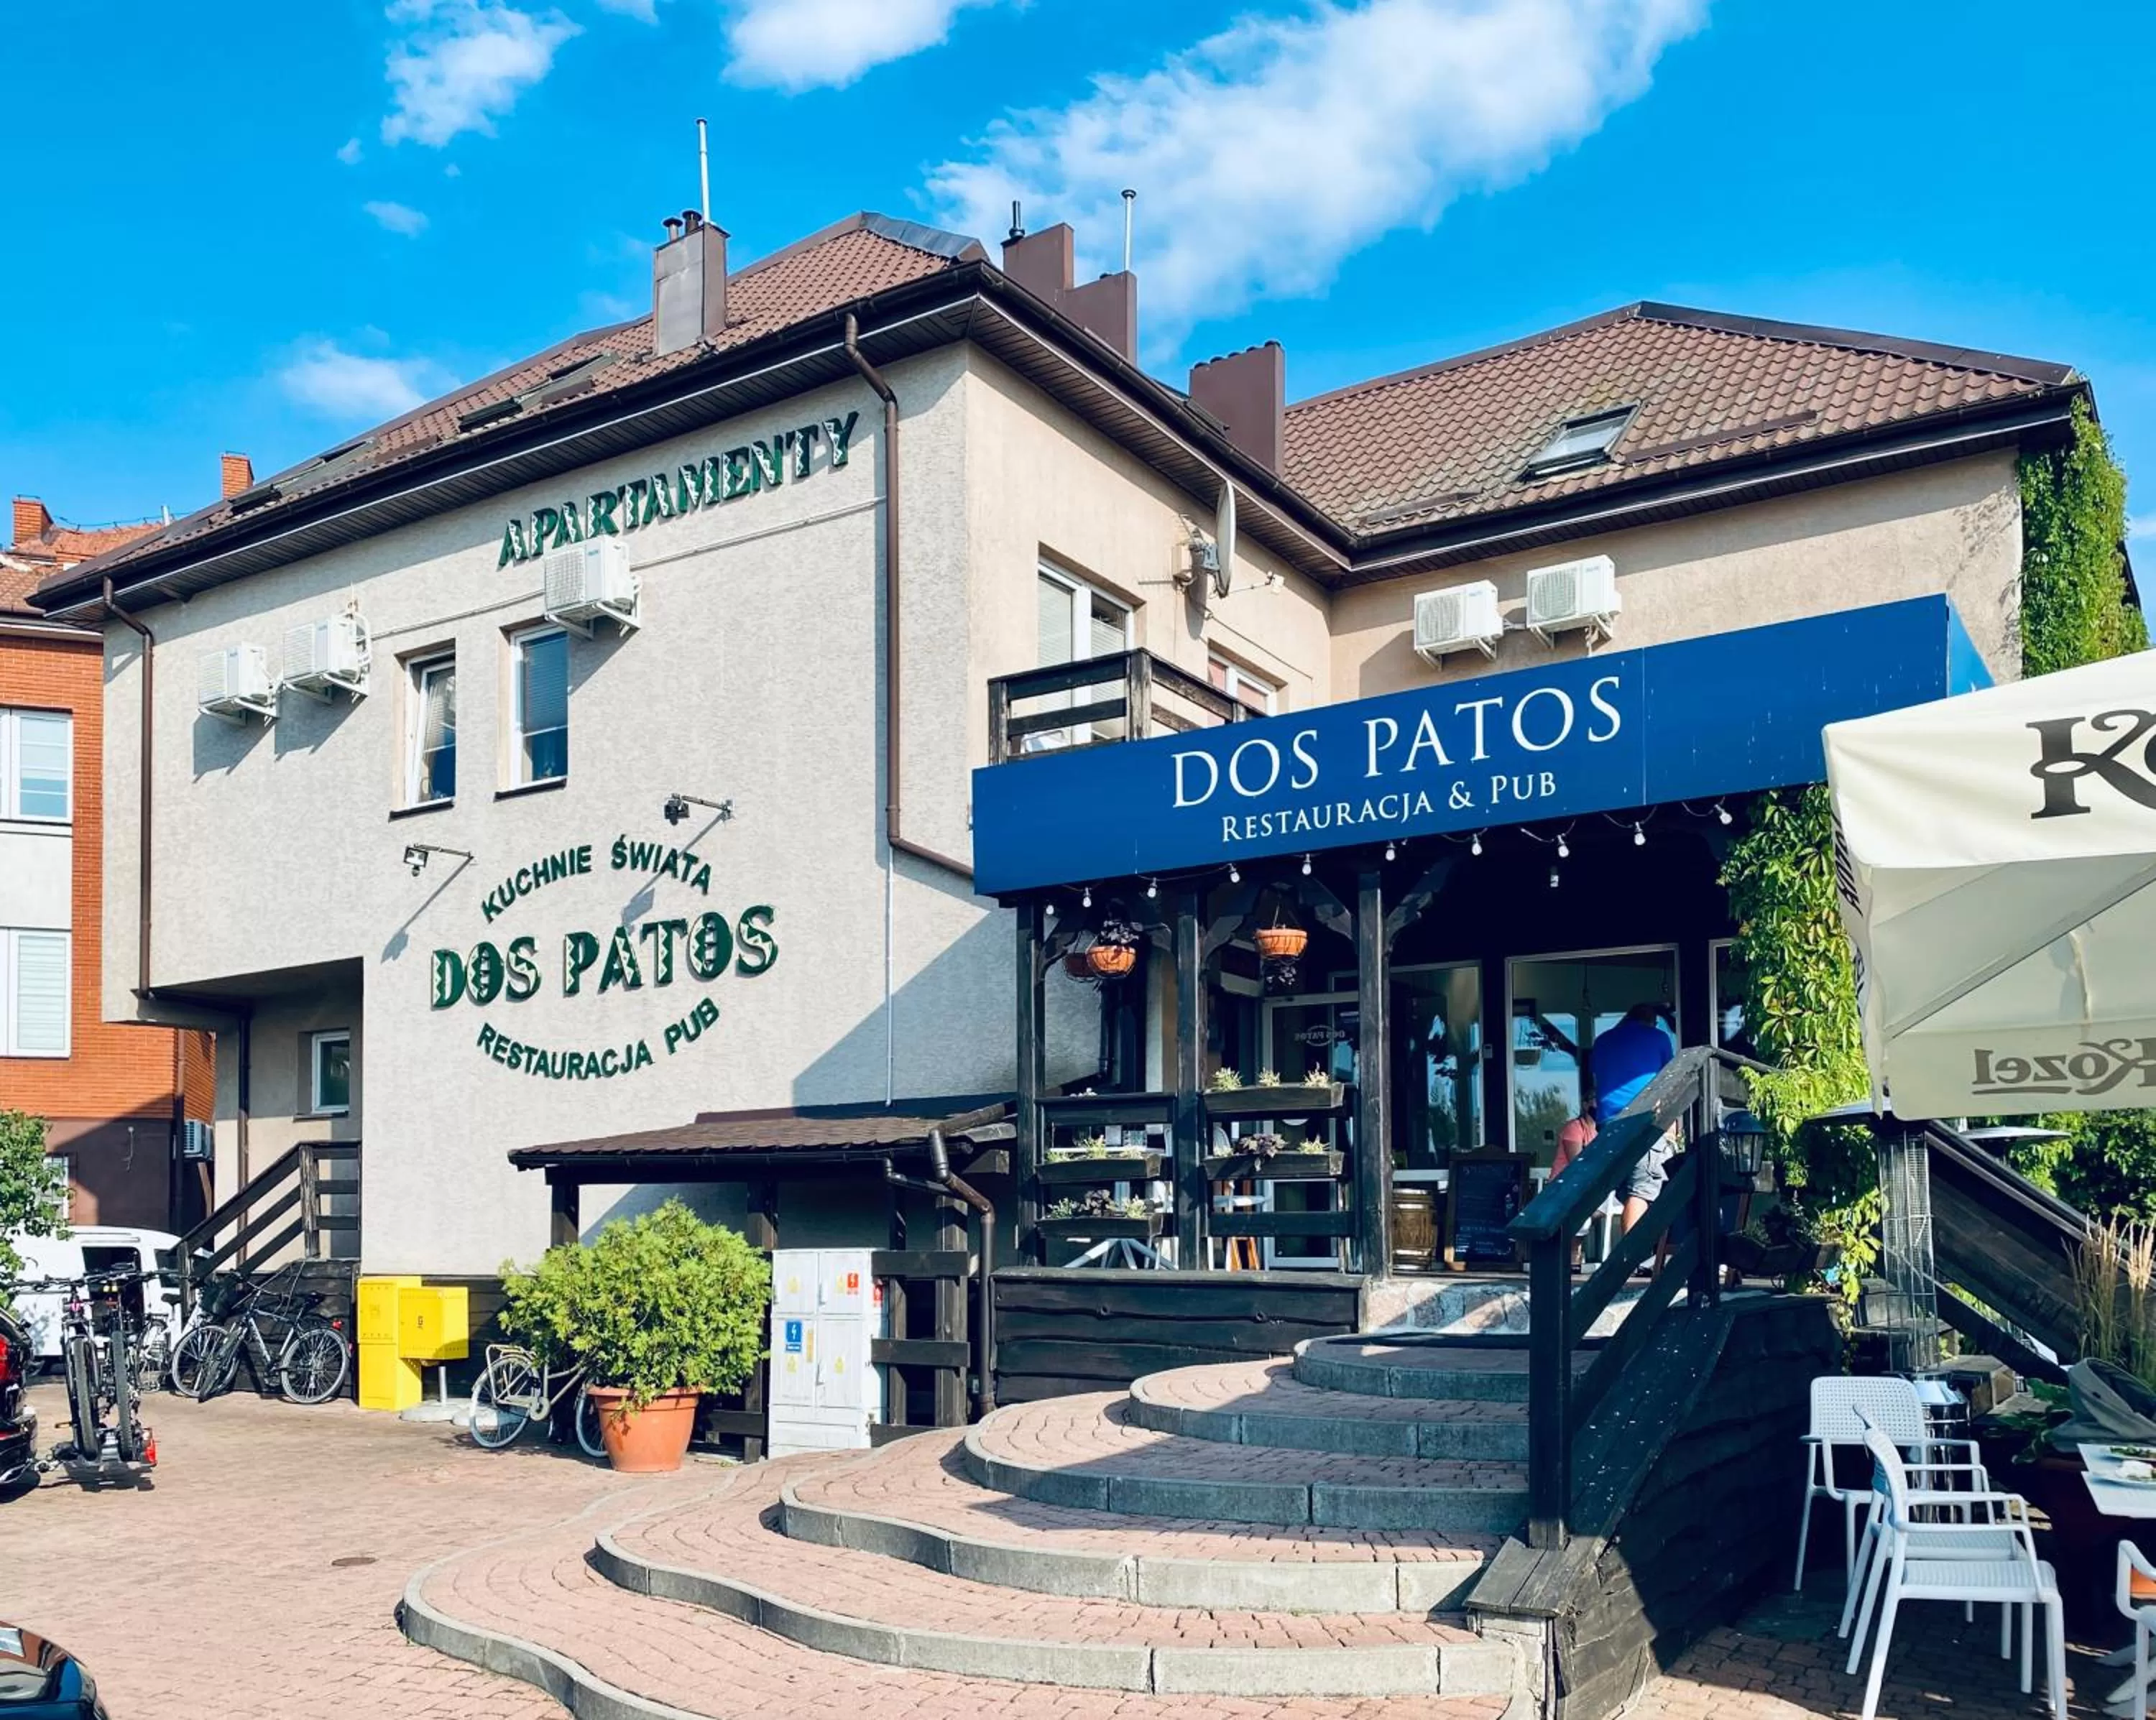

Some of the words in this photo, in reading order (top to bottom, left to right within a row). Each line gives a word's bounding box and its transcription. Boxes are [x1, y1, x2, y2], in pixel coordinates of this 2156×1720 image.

[498, 410, 860, 567] APARTAMENTY
[1172, 729, 1319, 808] DOS
[1364, 676, 1622, 778] PATOS
[2025, 708, 2156, 820] K
[1222, 792, 1434, 842] RESTAURACJA
[1447, 781, 1475, 810] &
[481, 844, 593, 924] KUCHNIE
[610, 834, 713, 895] ŚWIATA
[430, 935, 540, 1009] DOS
[563, 905, 778, 996] PATOS
[476, 1022, 655, 1080] RESTAURACJA
[663, 997, 719, 1055] PUB
